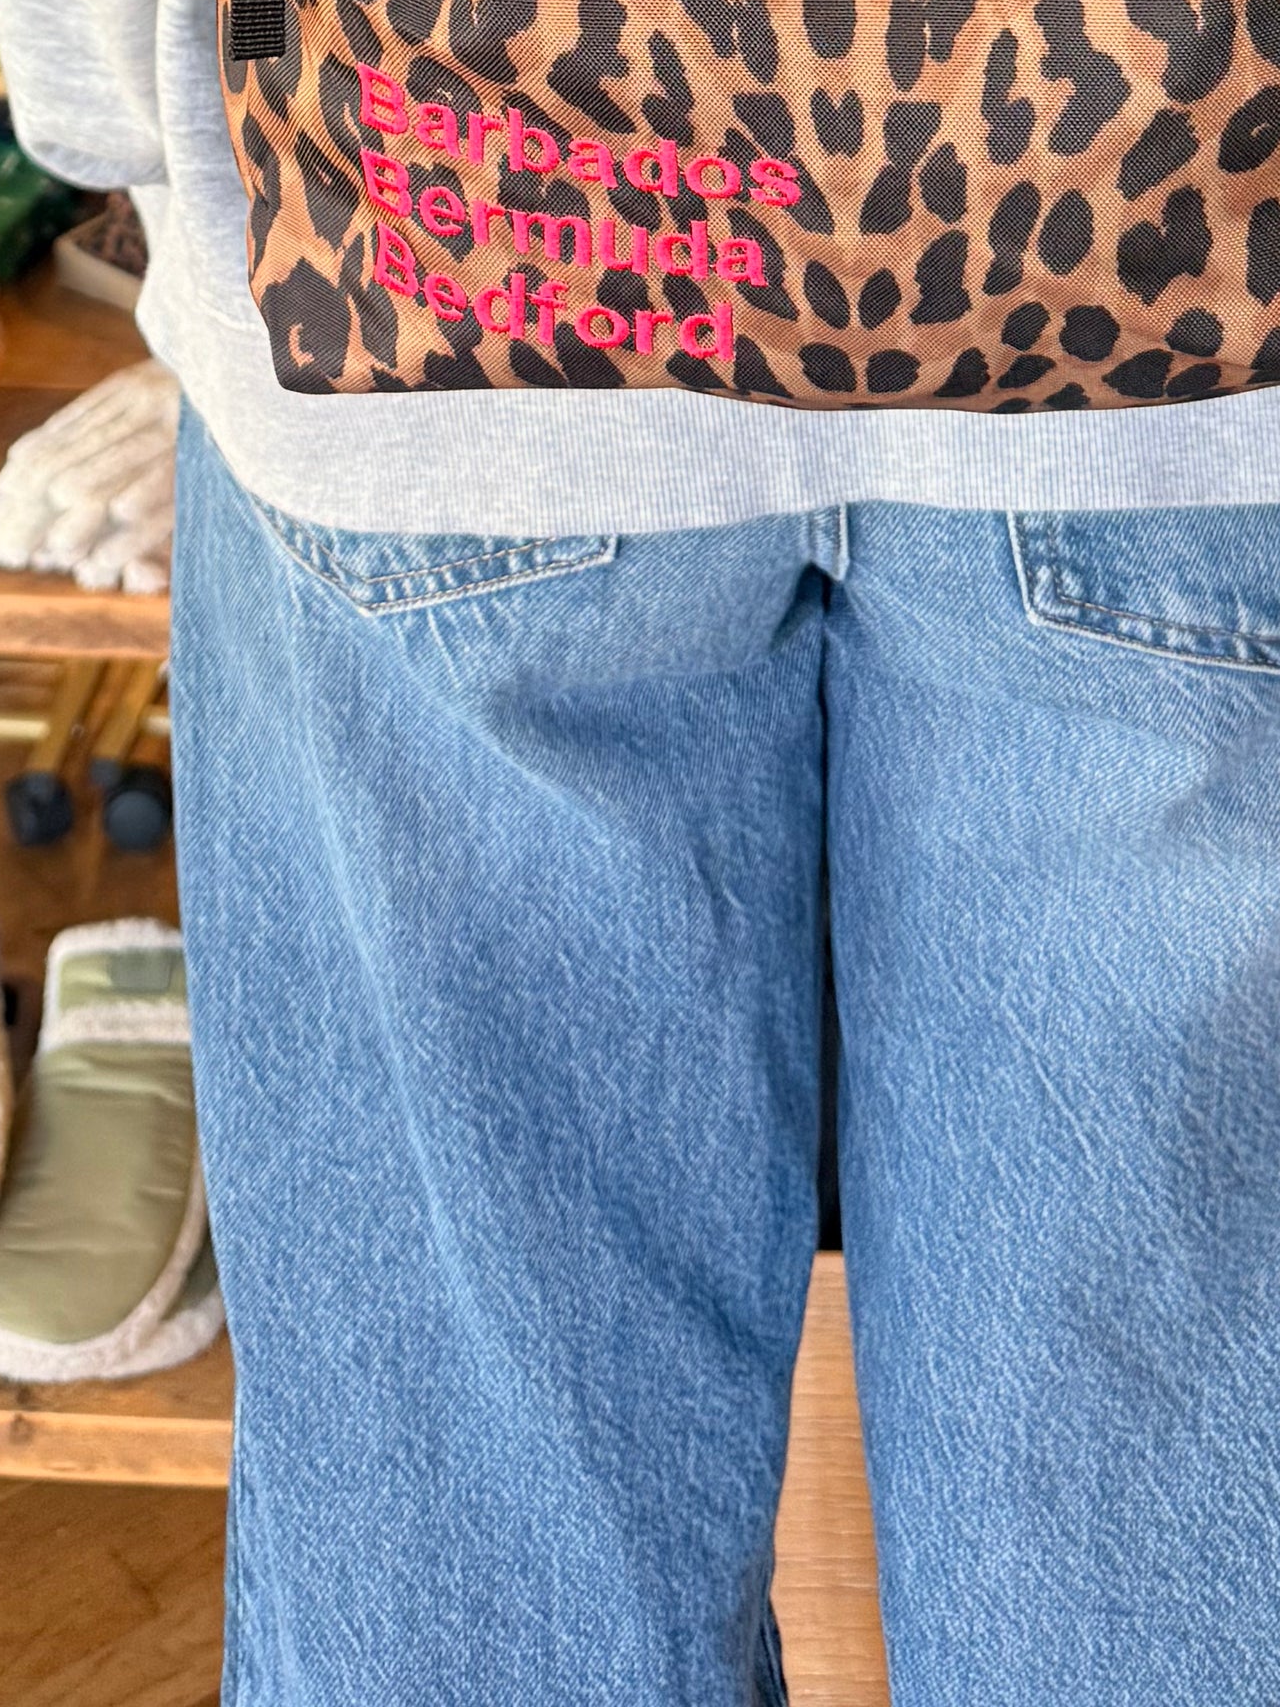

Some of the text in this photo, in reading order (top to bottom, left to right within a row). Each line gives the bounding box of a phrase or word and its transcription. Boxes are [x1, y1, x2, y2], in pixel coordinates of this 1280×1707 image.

[358, 63, 803, 208] Barbados
[360, 147, 768, 288] Bermuda
[374, 223, 737, 362] Bedford
